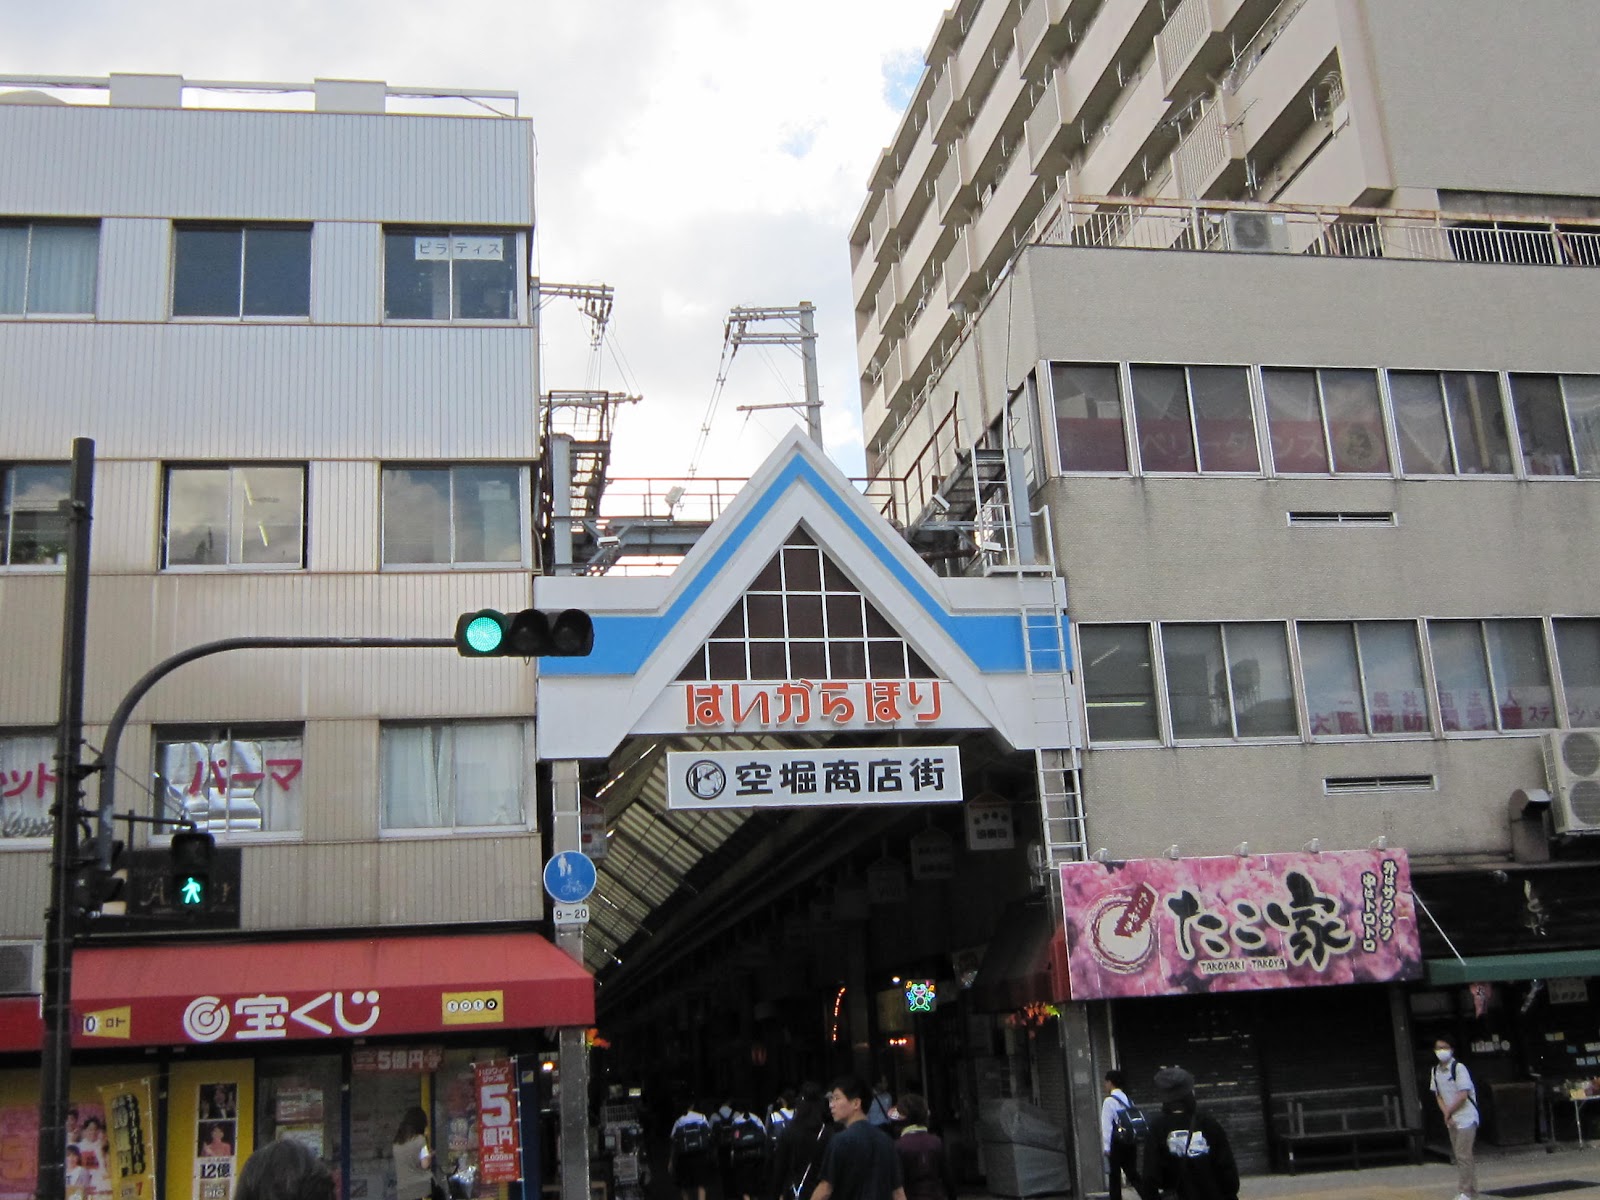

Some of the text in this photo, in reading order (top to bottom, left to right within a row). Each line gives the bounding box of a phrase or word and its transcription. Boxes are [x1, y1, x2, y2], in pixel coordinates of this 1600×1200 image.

[419, 241, 500, 256] ピラティス
[686, 679, 943, 726] はいからほり
[187, 759, 302, 796] パーマ
[735, 758, 945, 796] 空堀商店街
[1362, 872, 1376, 952] 中はトロトロ
[1380, 860, 1397, 941] 外はサクサク
[1201, 958, 1286, 971] TAKOYAKI TAKOYA
[235, 990, 380, 1039] 宝くじ
[446, 998, 497, 1013] toto
[201, 1162, 231, 1179] 12億
